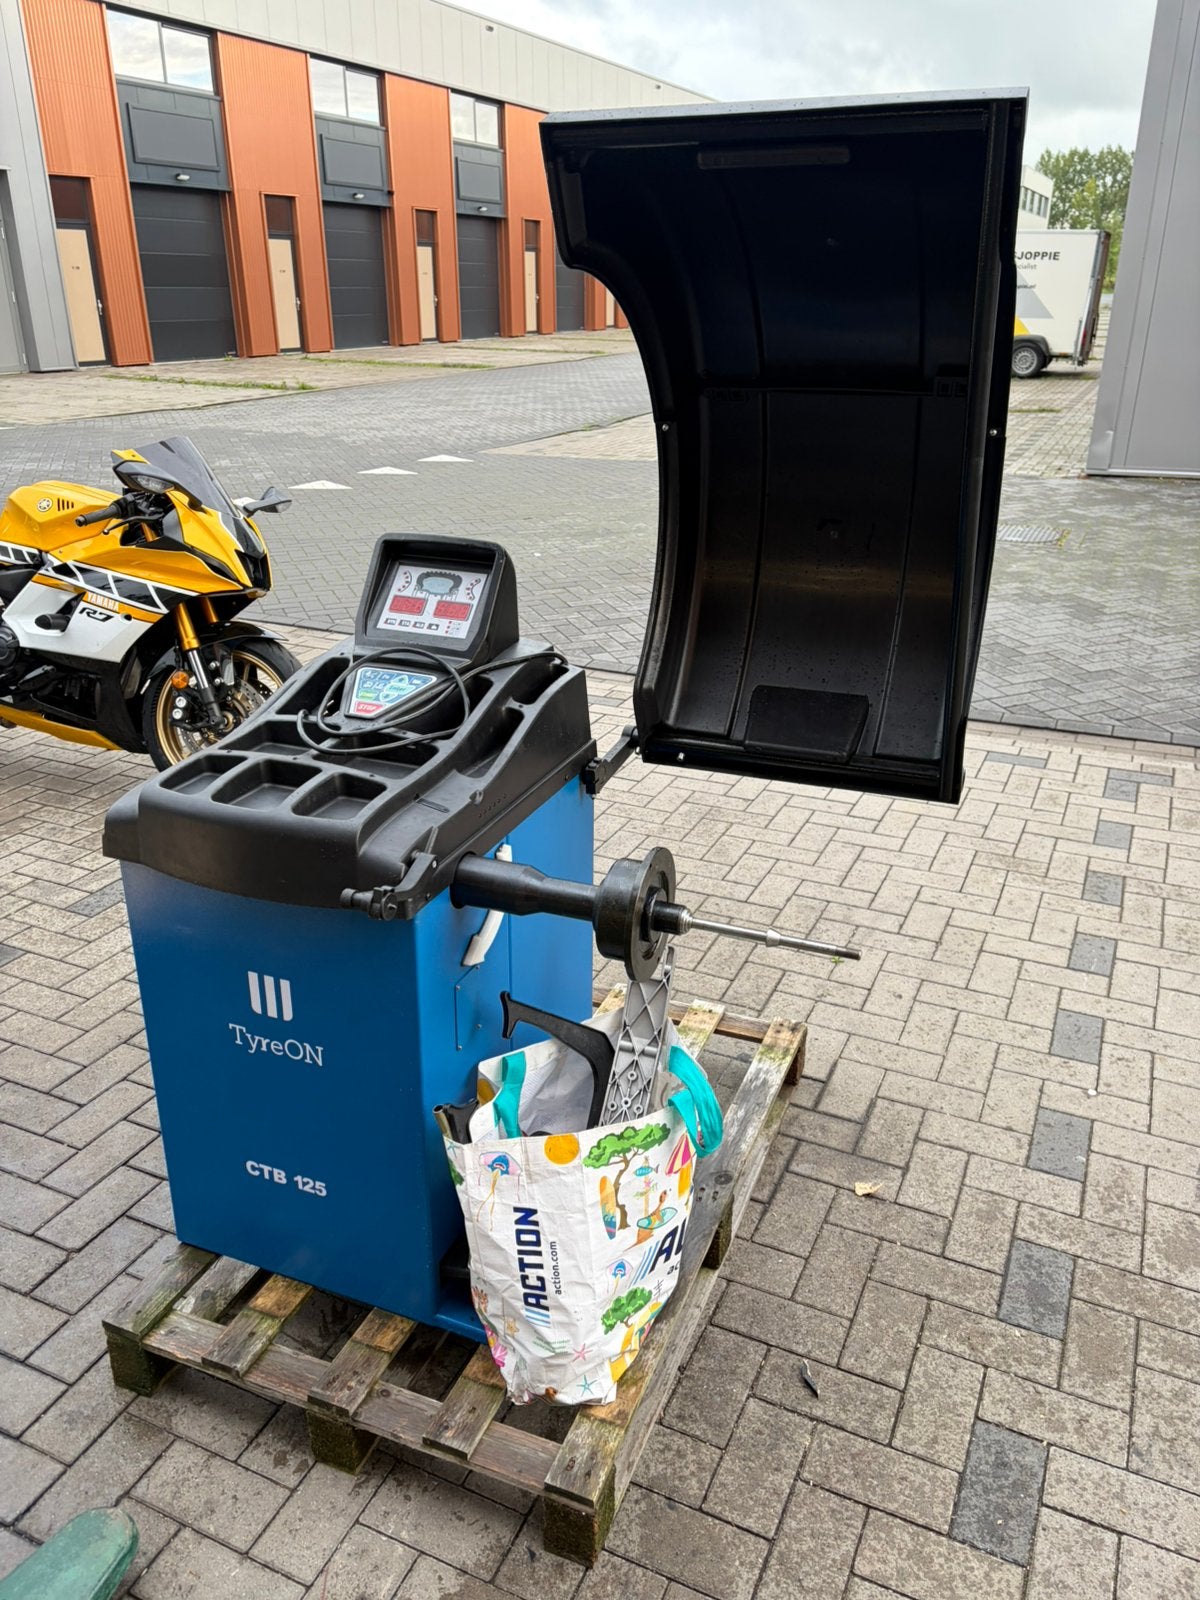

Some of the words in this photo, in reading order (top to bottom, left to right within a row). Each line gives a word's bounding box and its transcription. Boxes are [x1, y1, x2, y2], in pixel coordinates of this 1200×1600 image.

[79, 606, 114, 622] R7
[87, 591, 119, 612] YAMAHA
[357, 703, 377, 711] STOP
[229, 1023, 324, 1067] TyreON
[246, 1160, 287, 1185] CTB
[293, 1175, 327, 1197] 125
[513, 1206, 550, 1312] ACTION
[550, 1241, 562, 1295] action.com
